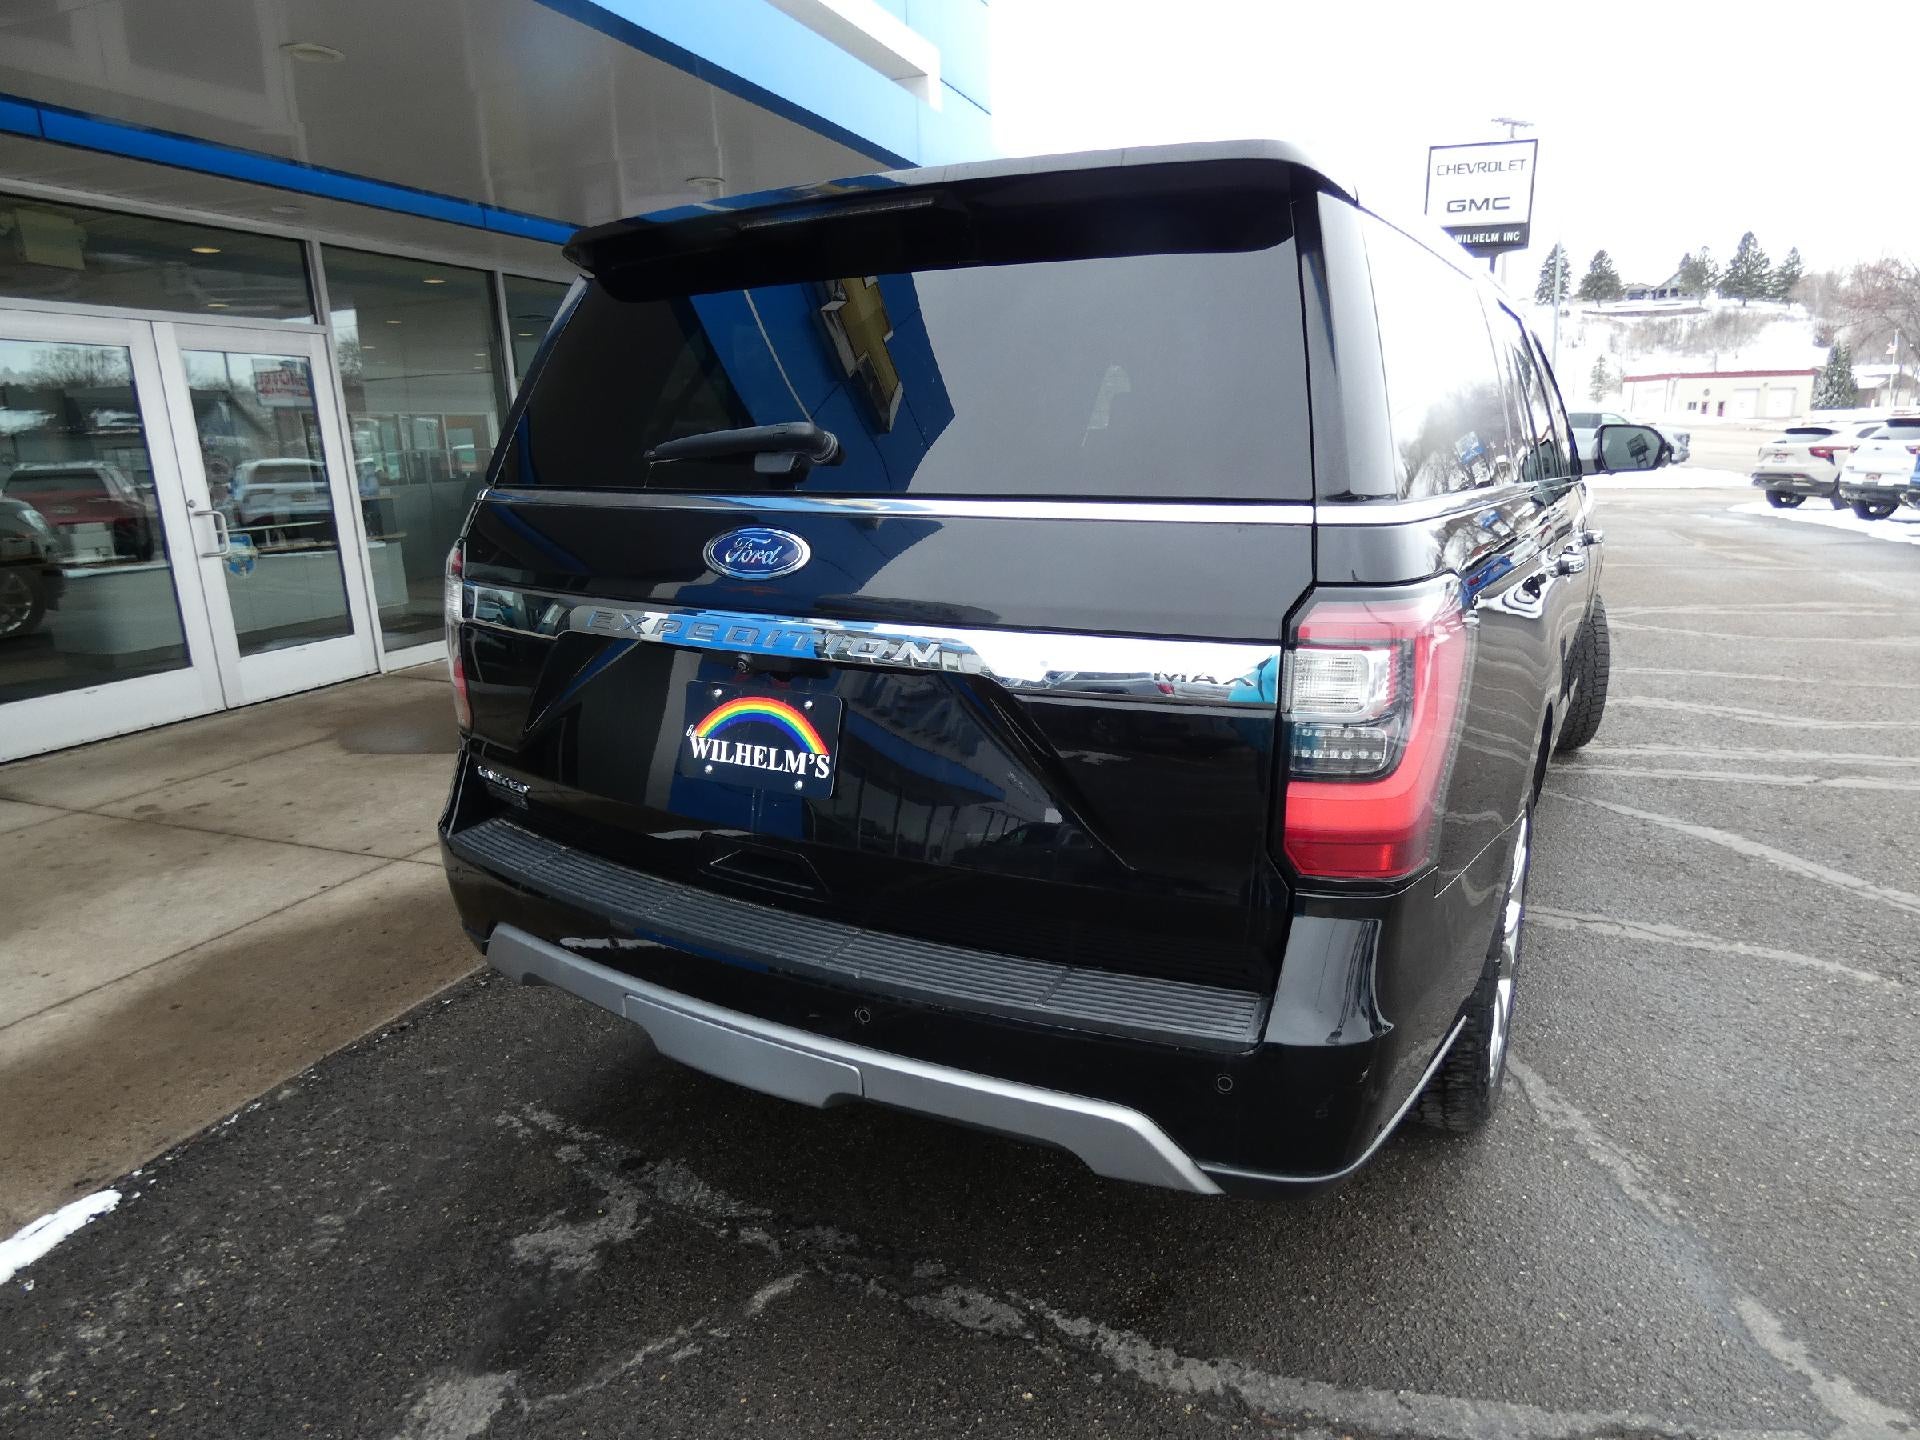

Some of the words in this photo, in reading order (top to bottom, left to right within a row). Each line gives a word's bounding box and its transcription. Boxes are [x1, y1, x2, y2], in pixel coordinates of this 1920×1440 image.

[1436, 159, 1527, 176] CHEVROLET
[1446, 197, 1510, 213] GMC
[1503, 231, 1521, 242] INC
[725, 536, 782, 565] Ford
[586, 610, 943, 664] EXPEDITION
[690, 736, 830, 779] WILHELM'S
